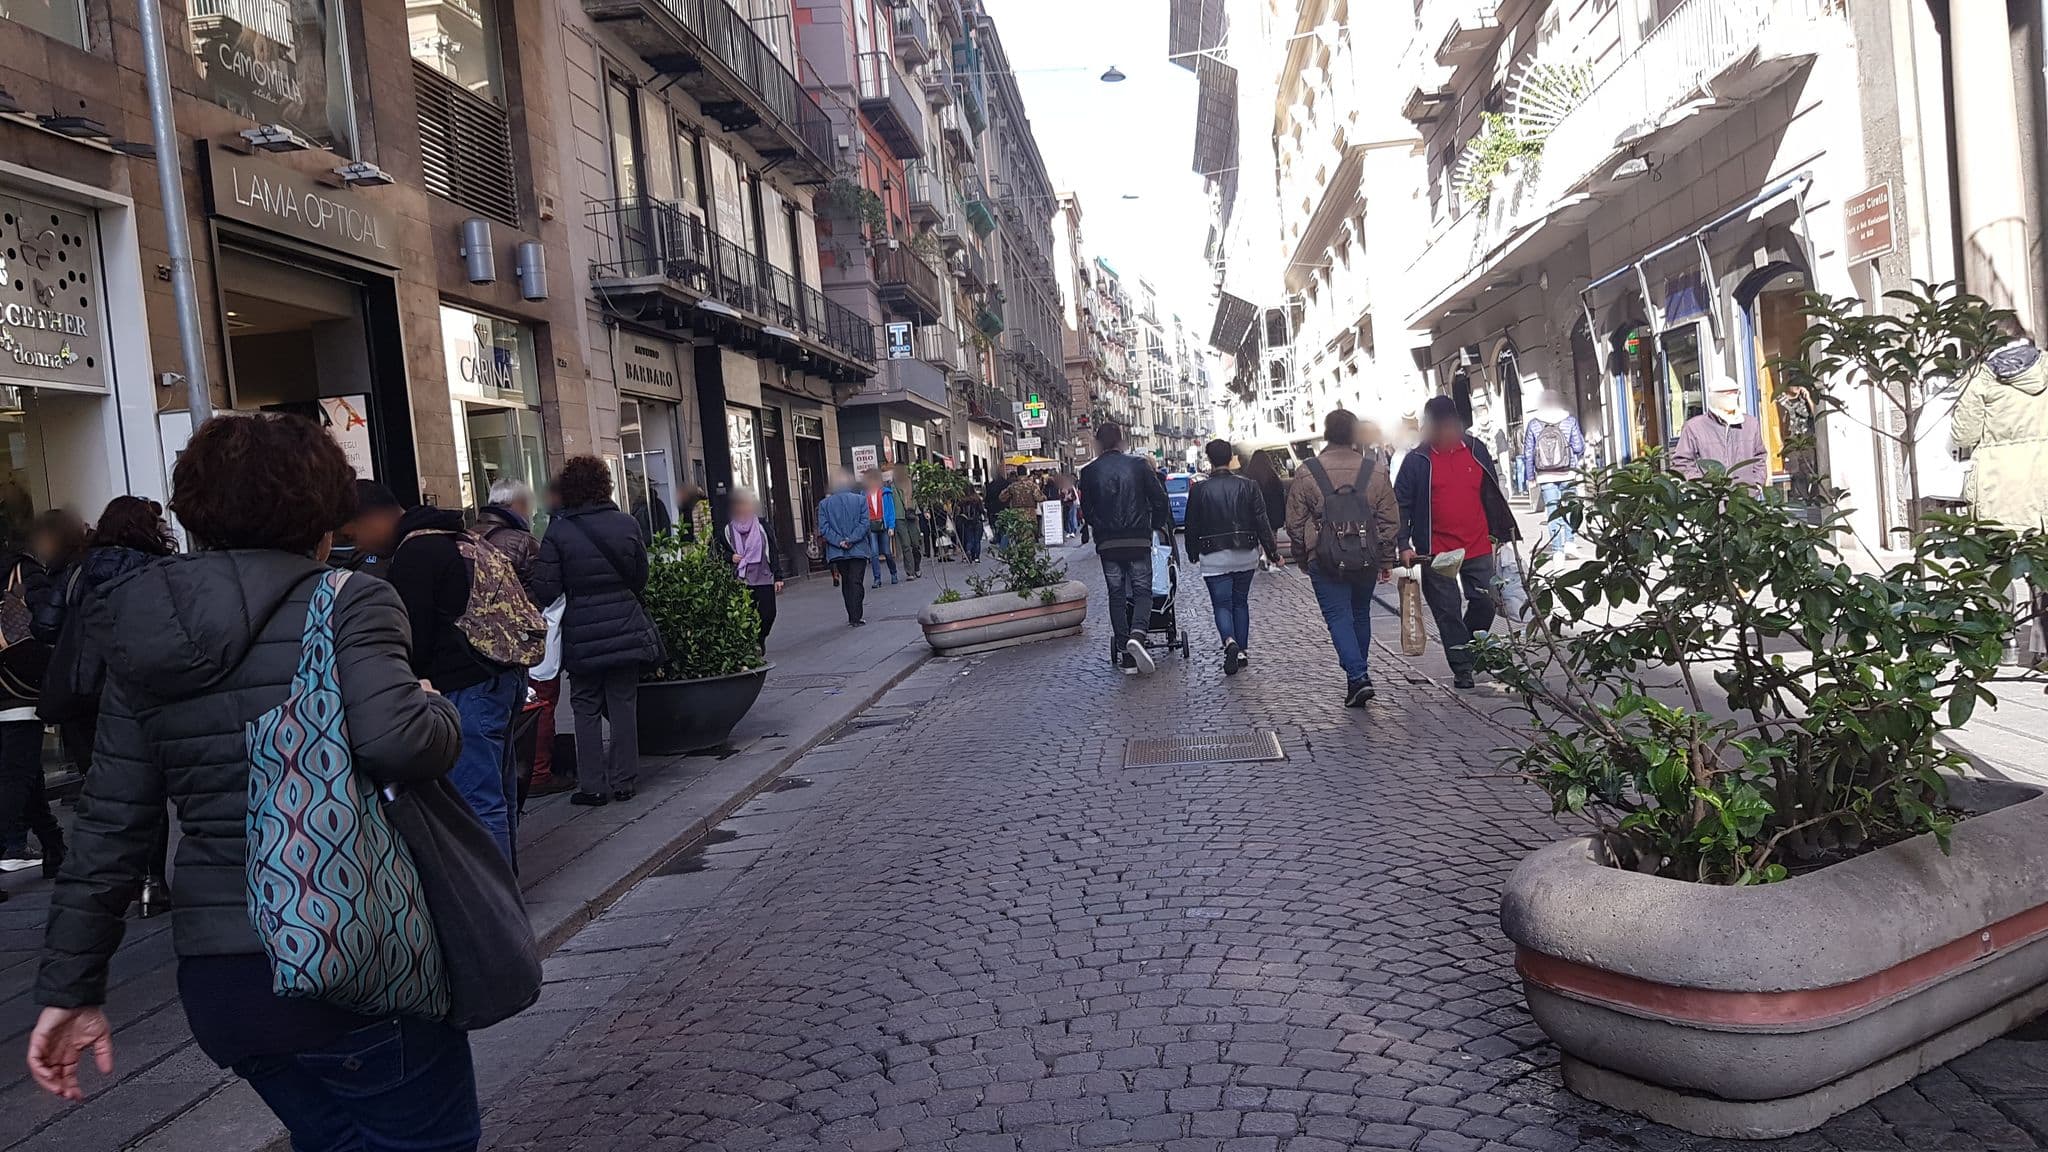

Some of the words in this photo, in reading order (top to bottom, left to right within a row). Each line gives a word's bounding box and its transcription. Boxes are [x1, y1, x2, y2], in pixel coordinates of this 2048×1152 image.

[219, 43, 303, 104] CAMOMILLA
[232, 167, 301, 222] LAMA
[304, 193, 386, 249] OPTICAL
[13, 342, 64, 369] donna
[460, 356, 513, 389] CARINA
[625, 362, 673, 387] BARBARO
[856, 455, 874, 463] ORO
